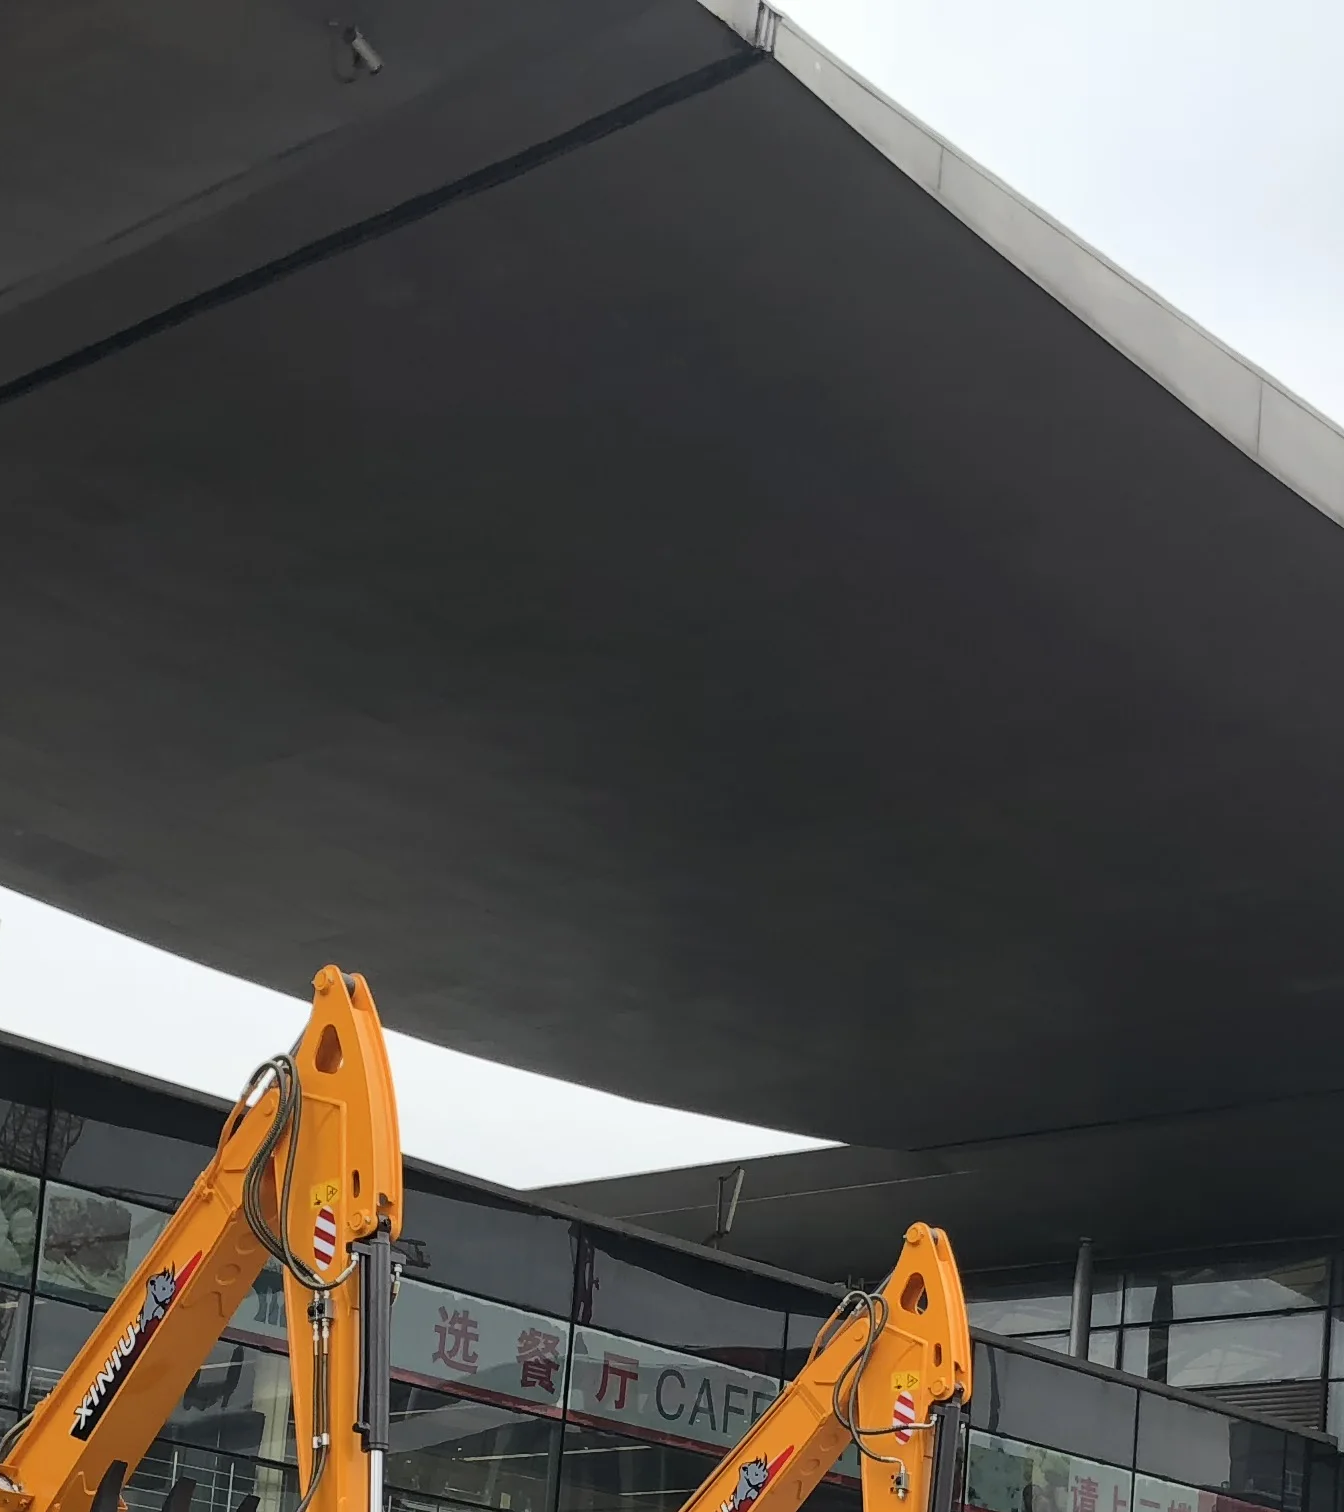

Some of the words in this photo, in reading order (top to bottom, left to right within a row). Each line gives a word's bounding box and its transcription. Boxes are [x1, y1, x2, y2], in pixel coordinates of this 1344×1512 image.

[74, 1320, 139, 1430] XINIU
[432, 1306, 639, 1410] 选餐厅
